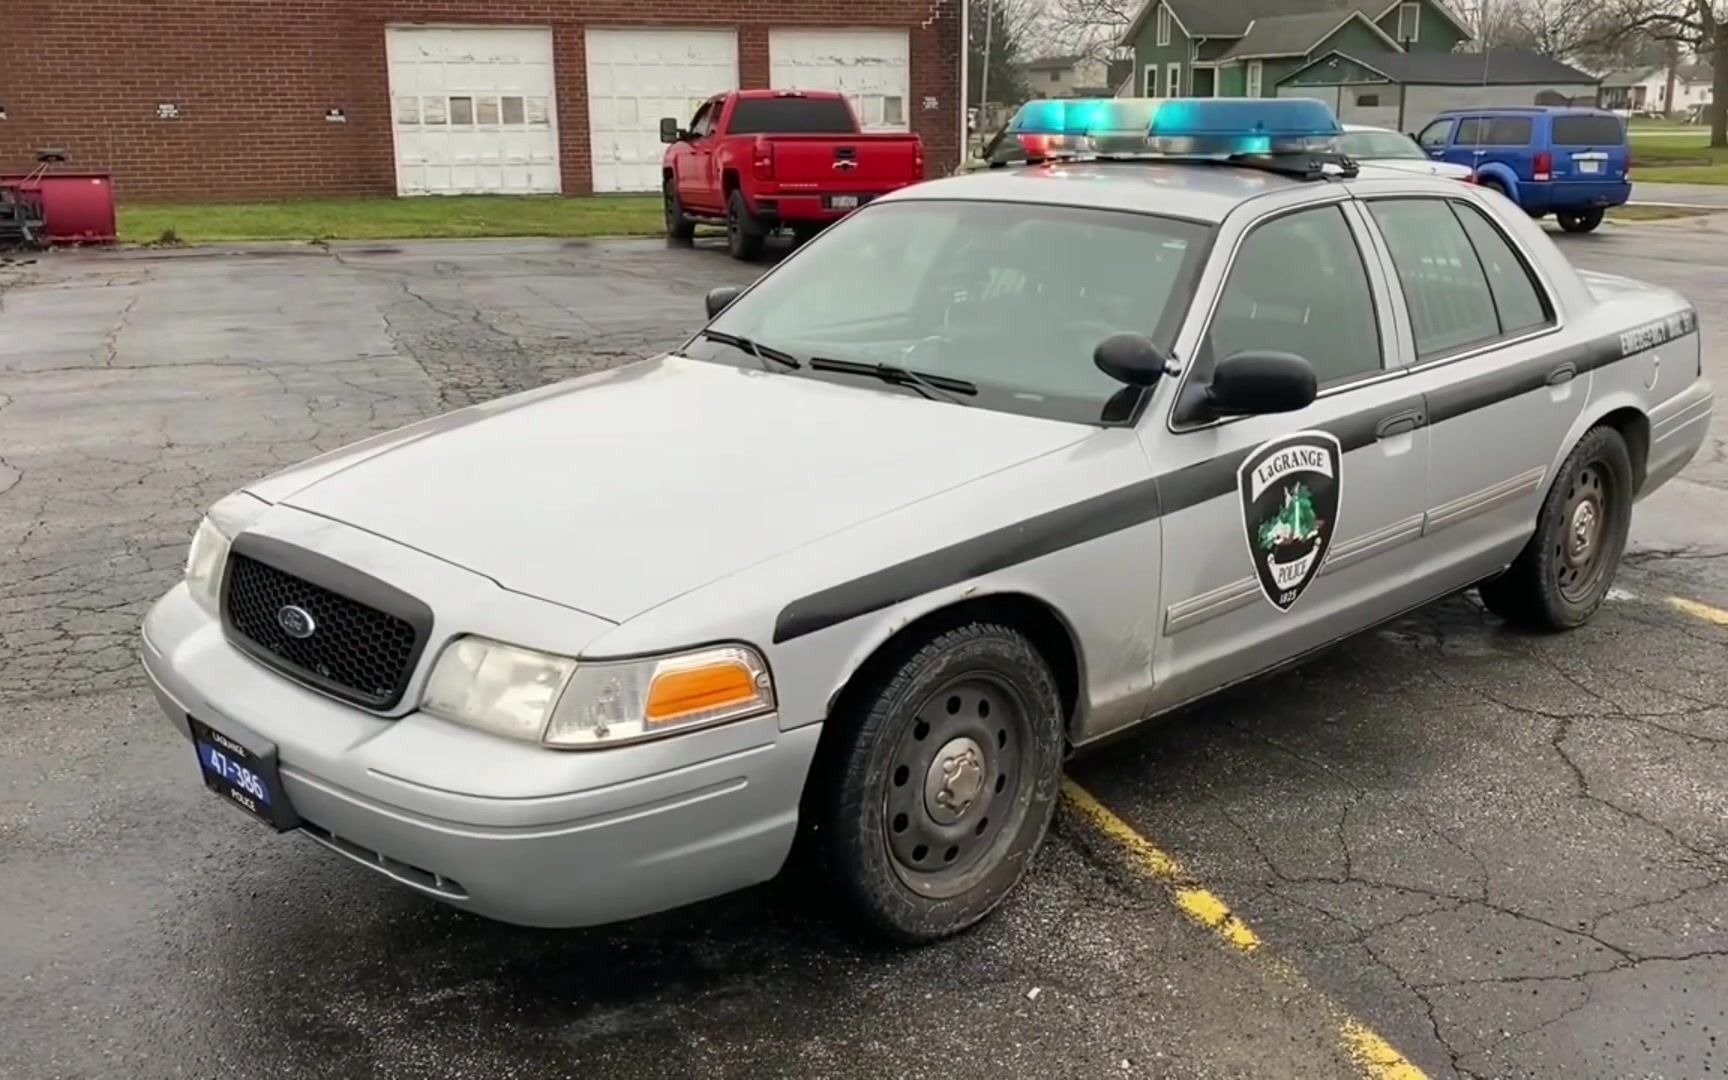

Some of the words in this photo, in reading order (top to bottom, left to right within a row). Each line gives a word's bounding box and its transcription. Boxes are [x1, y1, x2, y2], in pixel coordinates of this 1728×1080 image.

[1258, 450, 1324, 484] LaGRANGE
[1278, 560, 1307, 584] POLICE
[211, 749, 264, 800] 47-386
